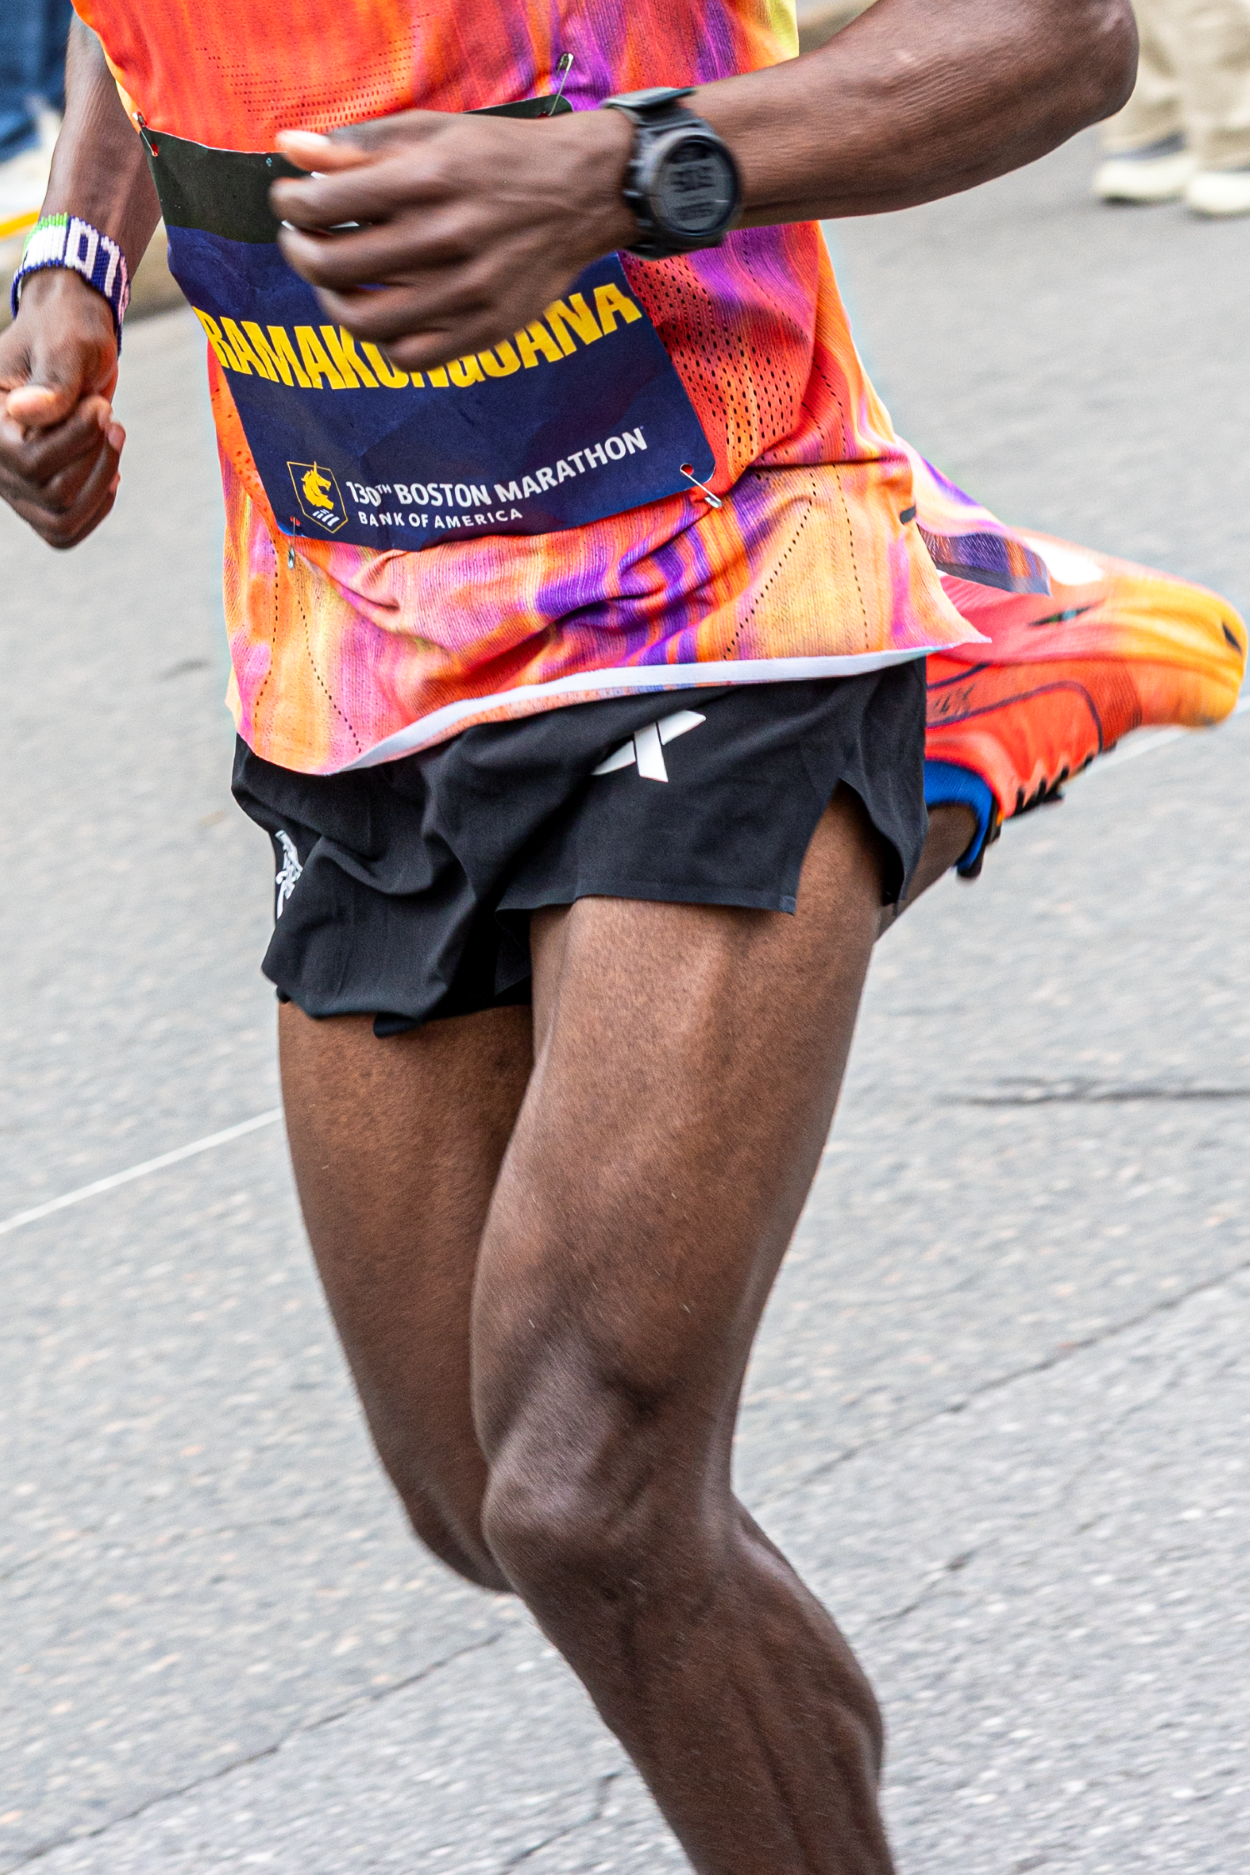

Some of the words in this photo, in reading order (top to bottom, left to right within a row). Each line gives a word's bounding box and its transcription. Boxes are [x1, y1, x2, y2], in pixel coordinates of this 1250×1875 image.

[393, 483, 492, 507] BOSTON
[494, 427, 648, 502] MARATHON
[358, 511, 405, 527] BANK
[408, 513, 429, 528] OF
[434, 508, 523, 529] AMERICA
